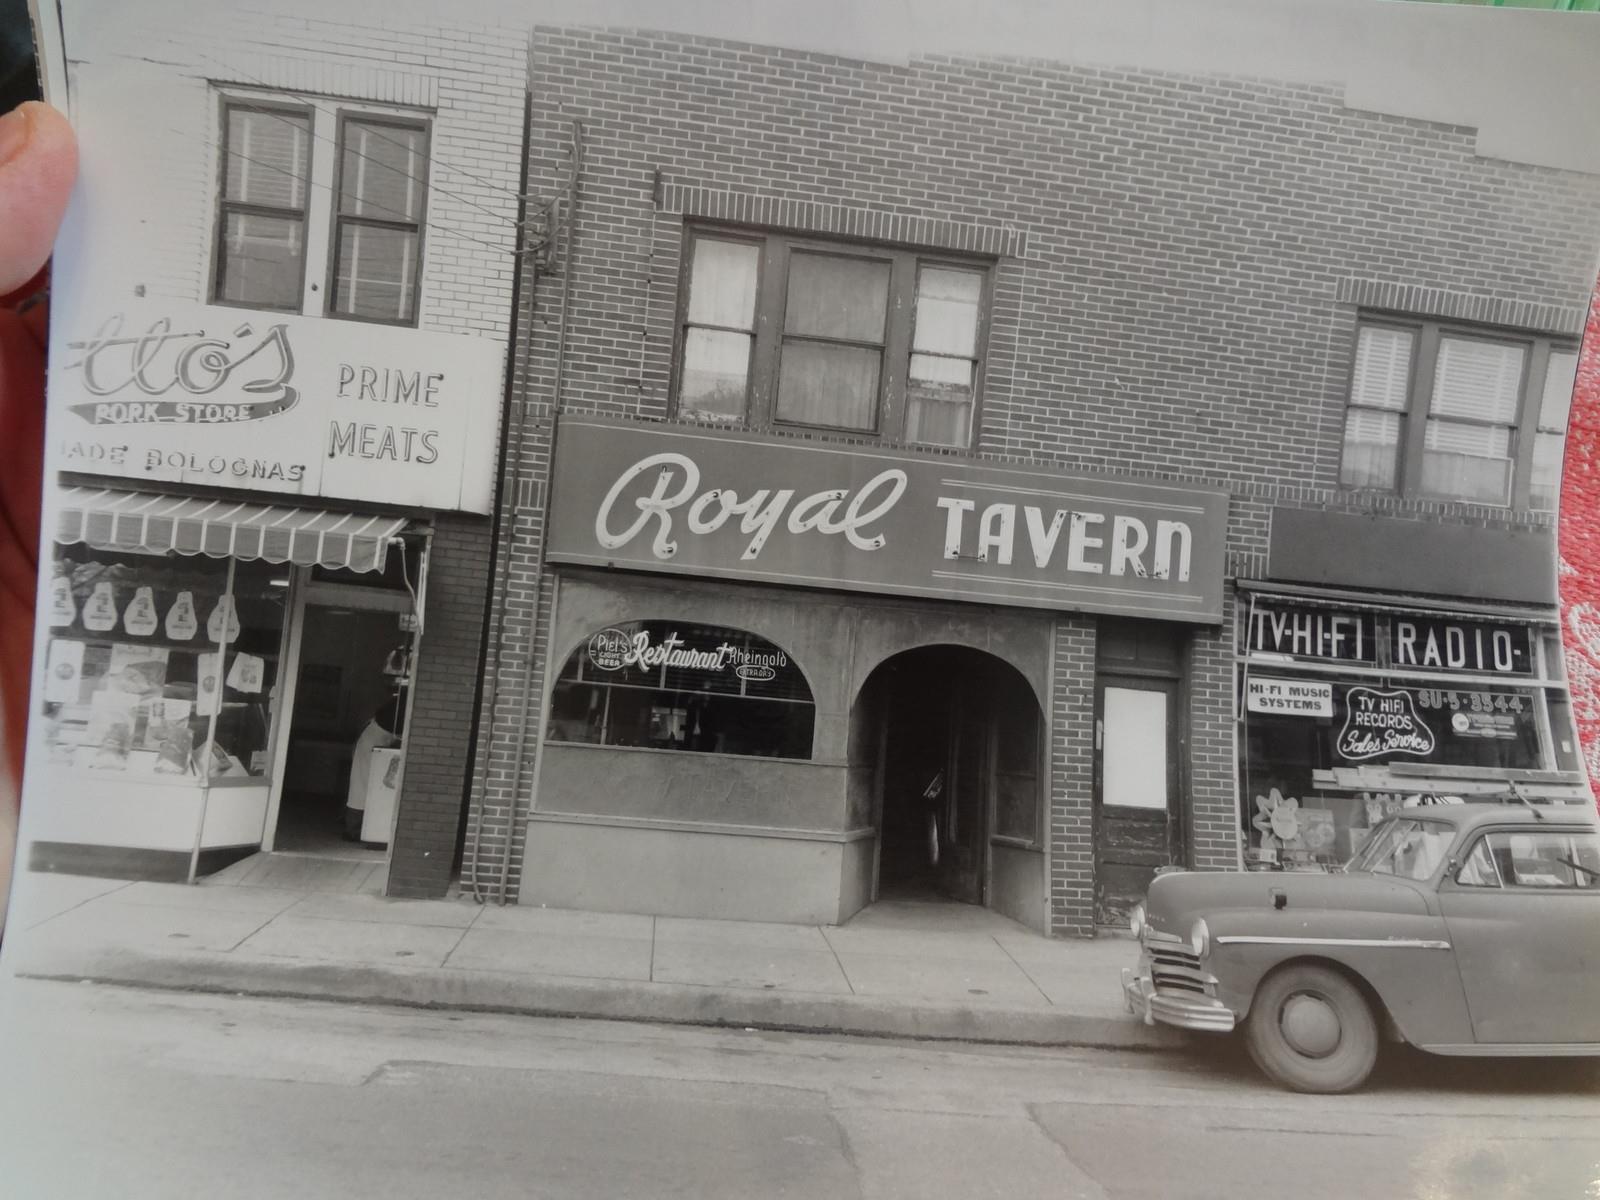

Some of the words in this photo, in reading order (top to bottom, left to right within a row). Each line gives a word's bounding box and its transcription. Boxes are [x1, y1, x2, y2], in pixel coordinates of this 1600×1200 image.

[64, 312, 294, 396] tto's
[337, 364, 444, 407] PRIME
[96, 402, 160, 424] PORK
[175, 402, 251, 424] STORE
[329, 421, 438, 464] MEATS
[145, 449, 306, 481] BOLOGNAS
[595, 452, 908, 559] Royal
[936, 496, 1192, 582] TAVERN
[1252, 608, 1362, 660] TV-HI-FI
[598, 658, 620, 667] BEER
[623, 630, 733, 672] Restaurant
[726, 646, 786, 668] Rheingold
[1249, 683, 1282, 695] HI-FI
[1288, 686, 1330, 698] MUSIC
[1259, 697, 1322, 710] SYSTEMS
[1358, 696, 1375, 711] TV
[1355, 711, 1413, 730] RECORDS
[1342, 730, 1380, 752] Sales
[1382, 729, 1430, 751] Service
